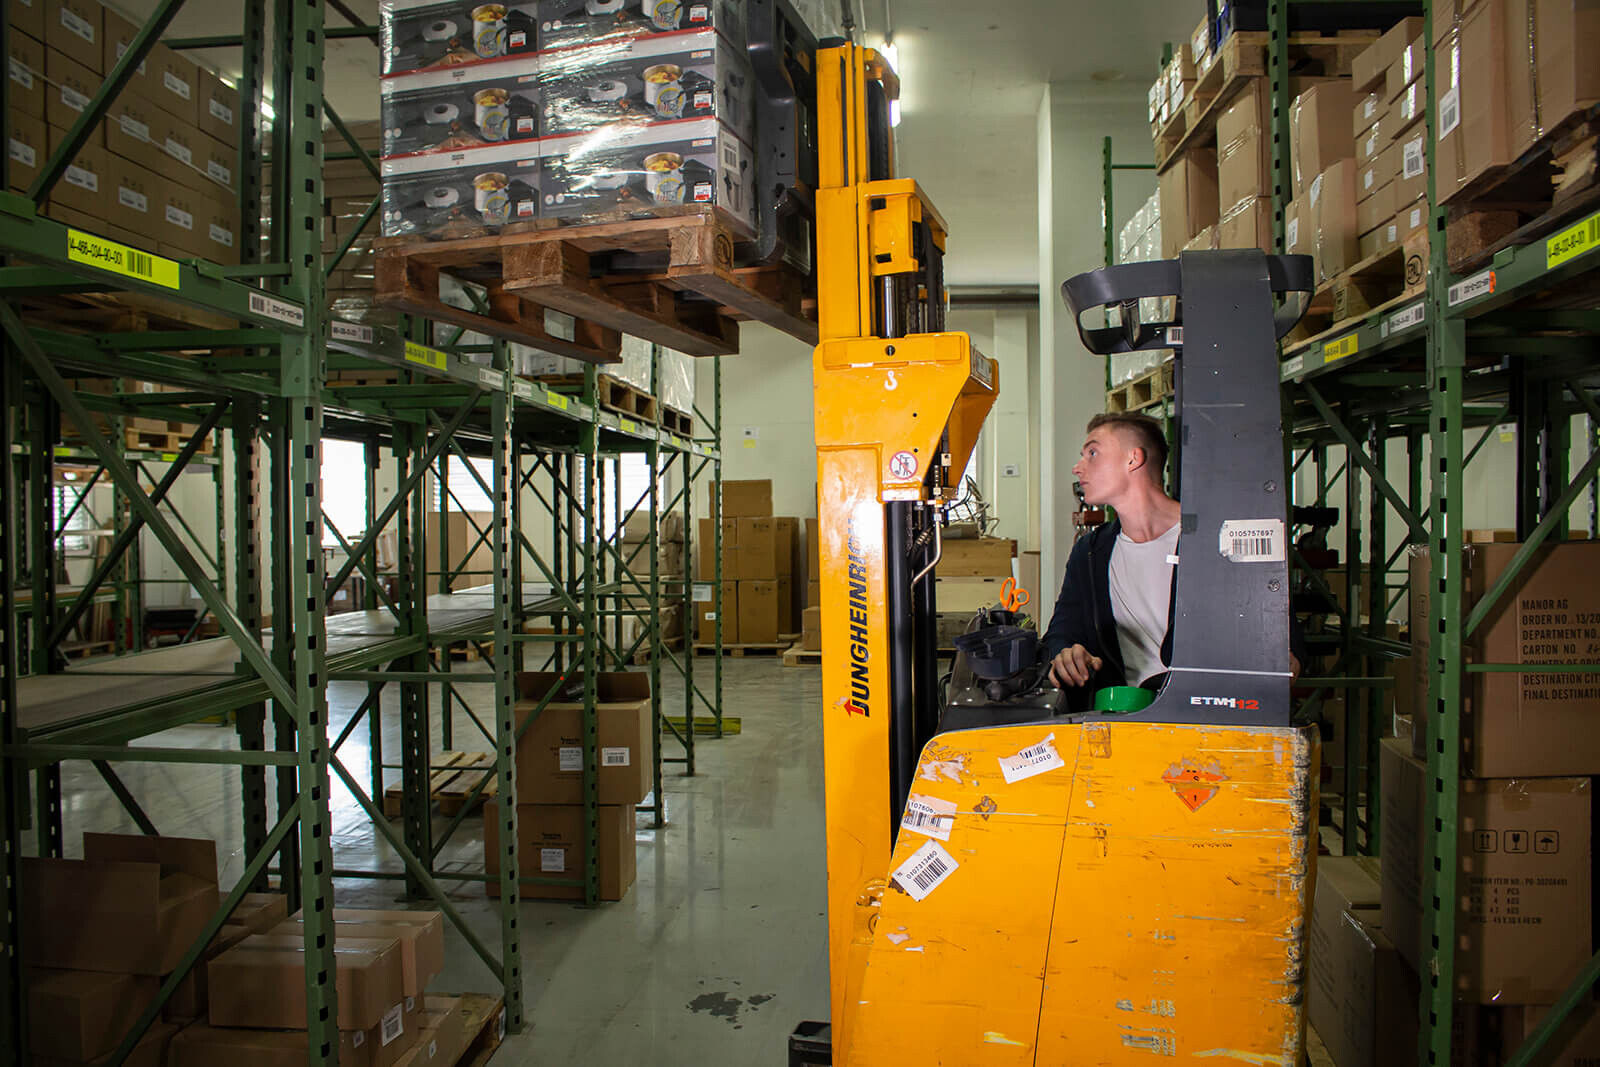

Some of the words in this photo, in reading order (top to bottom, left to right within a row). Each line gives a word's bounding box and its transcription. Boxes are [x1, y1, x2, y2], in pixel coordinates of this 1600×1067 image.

[1522, 599, 1554, 610] MANOR
[1522, 614, 1553, 625] ORDER
[1522, 628, 1582, 641] DEPARTMENT
[1522, 644, 1558, 655] CARTON
[1523, 673, 1583, 686] DESTINATION
[1523, 688, 1549, 700] FINAL
